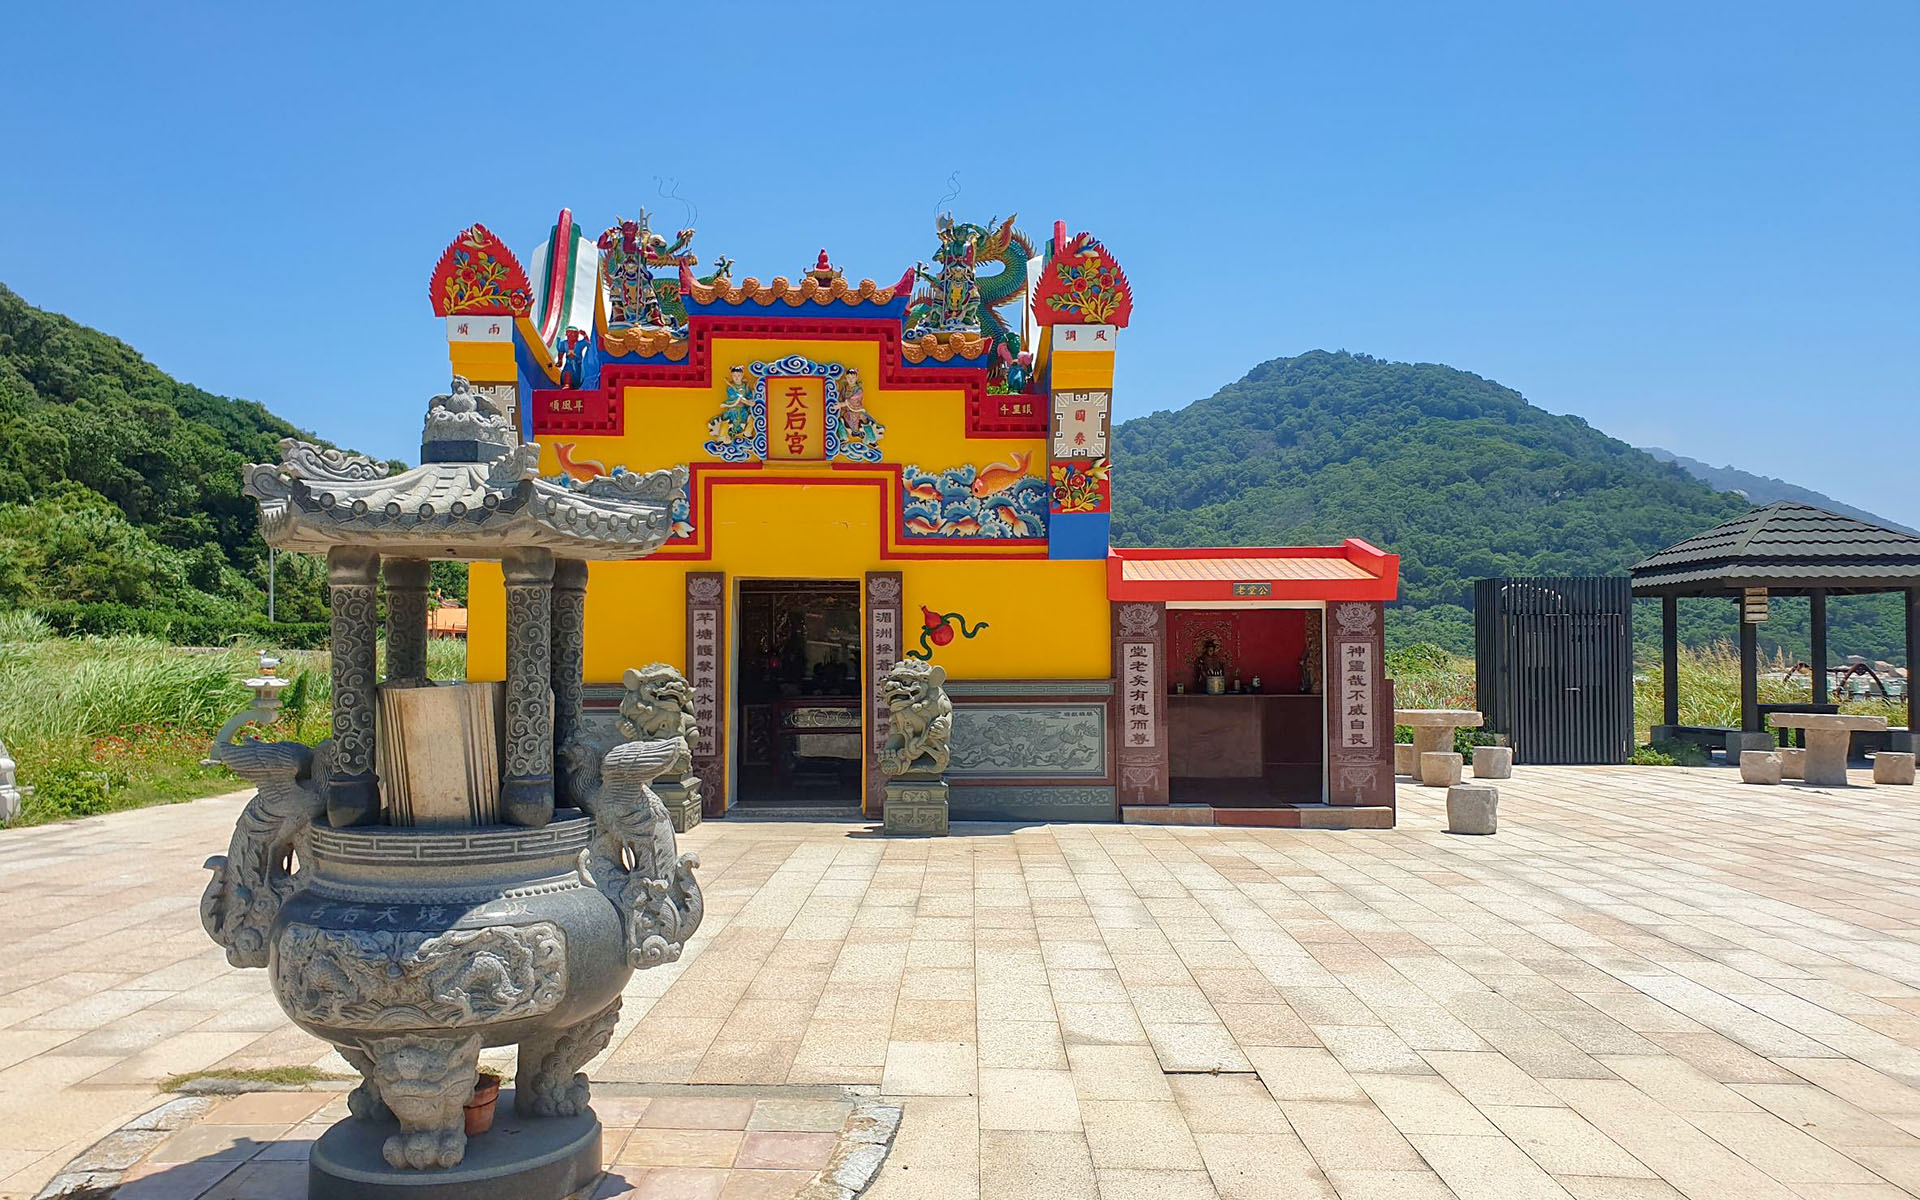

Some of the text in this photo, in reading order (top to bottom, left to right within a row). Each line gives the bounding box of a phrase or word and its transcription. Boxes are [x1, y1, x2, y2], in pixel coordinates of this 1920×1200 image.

[784, 386, 808, 455] 天后宮
[1000, 404, 1032, 415] 千里眼
[1074, 409, 1086, 445] 國泰
[1129, 645, 1149, 745] 堂老矣有德而尊
